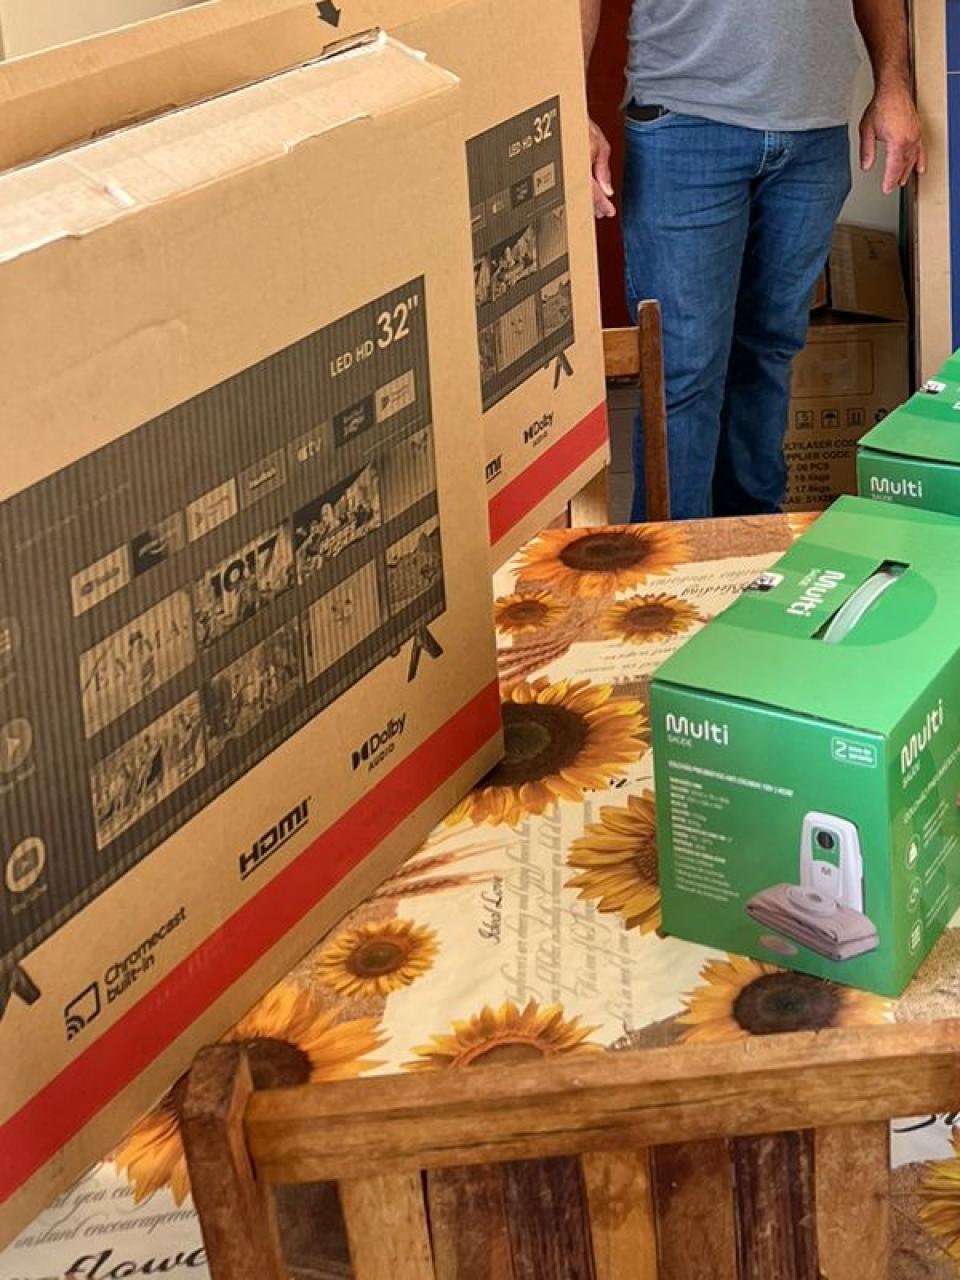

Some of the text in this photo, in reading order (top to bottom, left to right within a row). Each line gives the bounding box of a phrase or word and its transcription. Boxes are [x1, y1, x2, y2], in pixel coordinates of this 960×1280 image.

[330, 294, 419, 377] LED HD 32"
[869, 476, 923, 499] Multi
[786, 570, 846, 617] Multi
[370, 711, 407, 755] Dolby
[666, 713, 729, 746] Multi
[835, 739, 848, 758] 2
[901, 697, 943, 776] Multi
[240, 796, 311, 878] HDMI
[104, 906, 186, 986] Chromecast
[107, 953, 156, 1005] built-in
